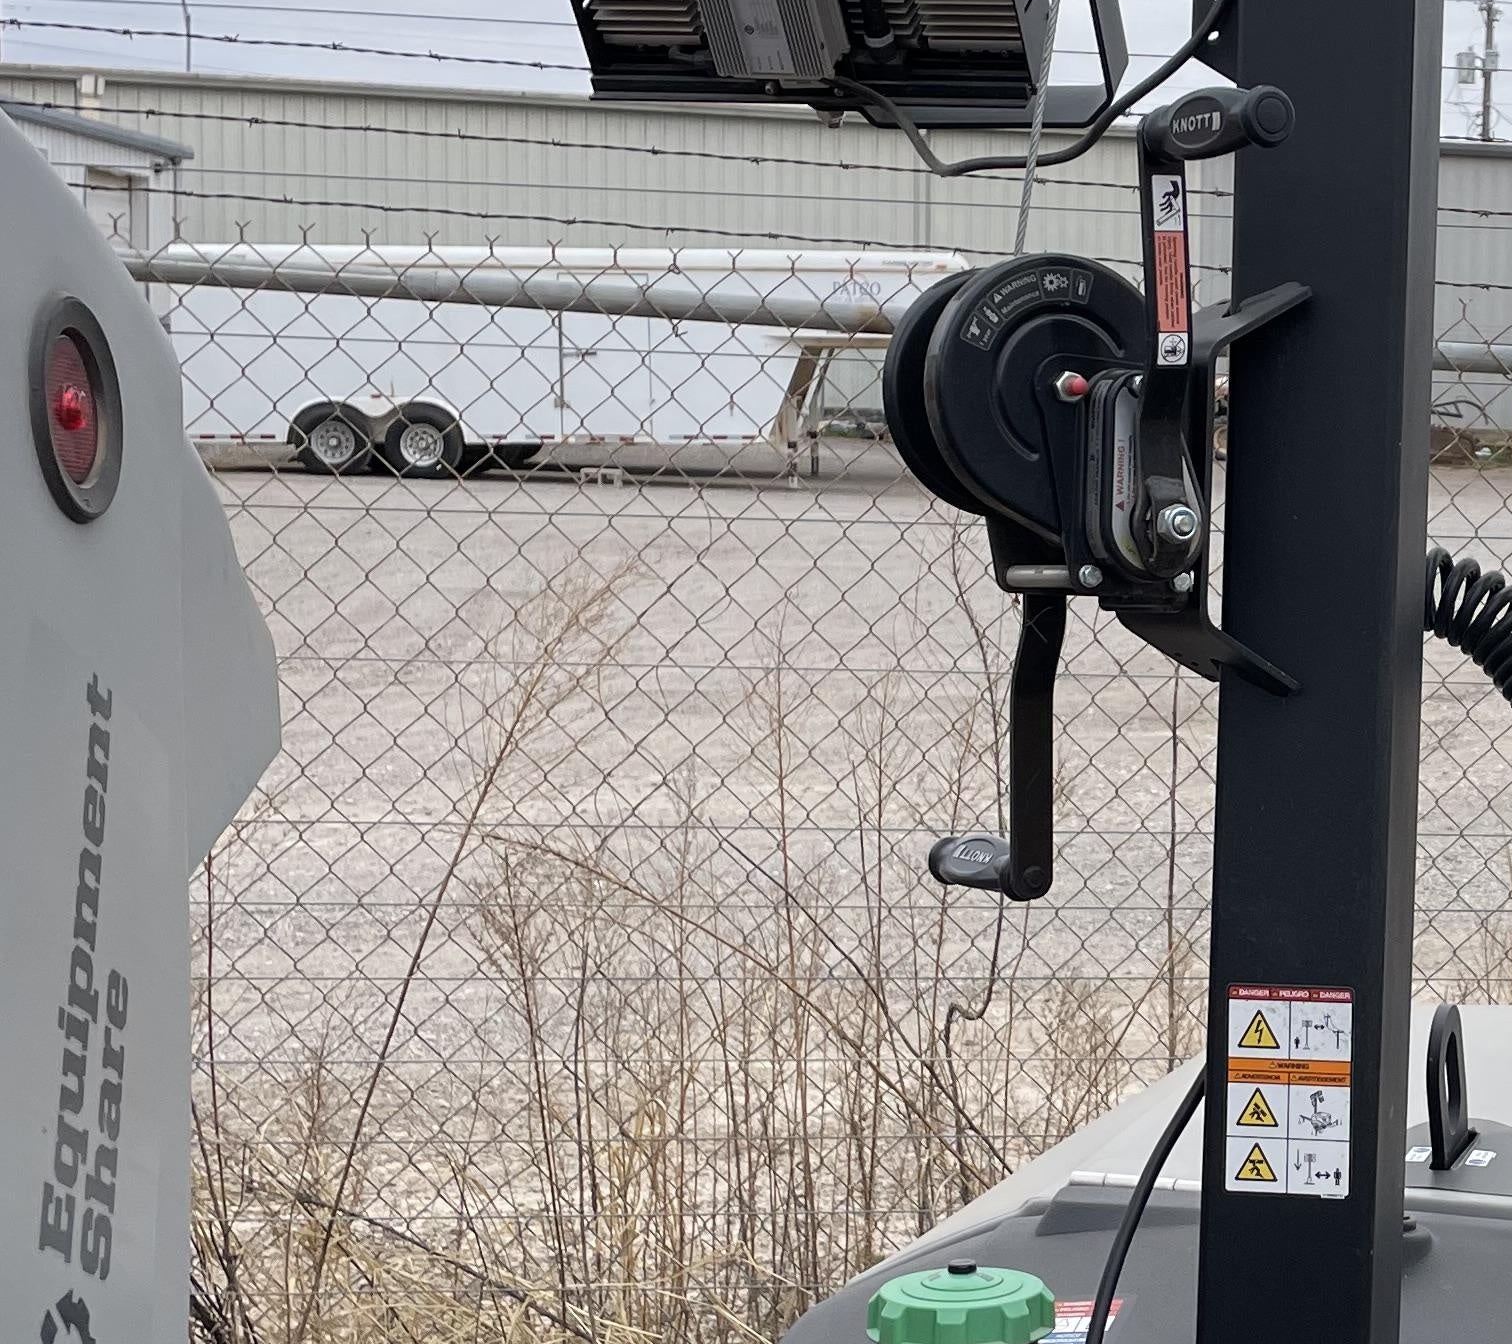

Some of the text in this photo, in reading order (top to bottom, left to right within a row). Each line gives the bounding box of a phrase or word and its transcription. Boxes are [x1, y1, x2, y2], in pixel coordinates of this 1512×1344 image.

[1172, 113, 1210, 134] KNOTT
[1001, 274, 1037, 295] WARNING
[1116, 445, 1126, 496] WARNING
[959, 848, 993, 864] KNOTT
[38, 672, 114, 1264] Equipment
[1238, 988, 1351, 1000] DANGER PELIGRO DANGER
[82, 968, 129, 1281] Share
